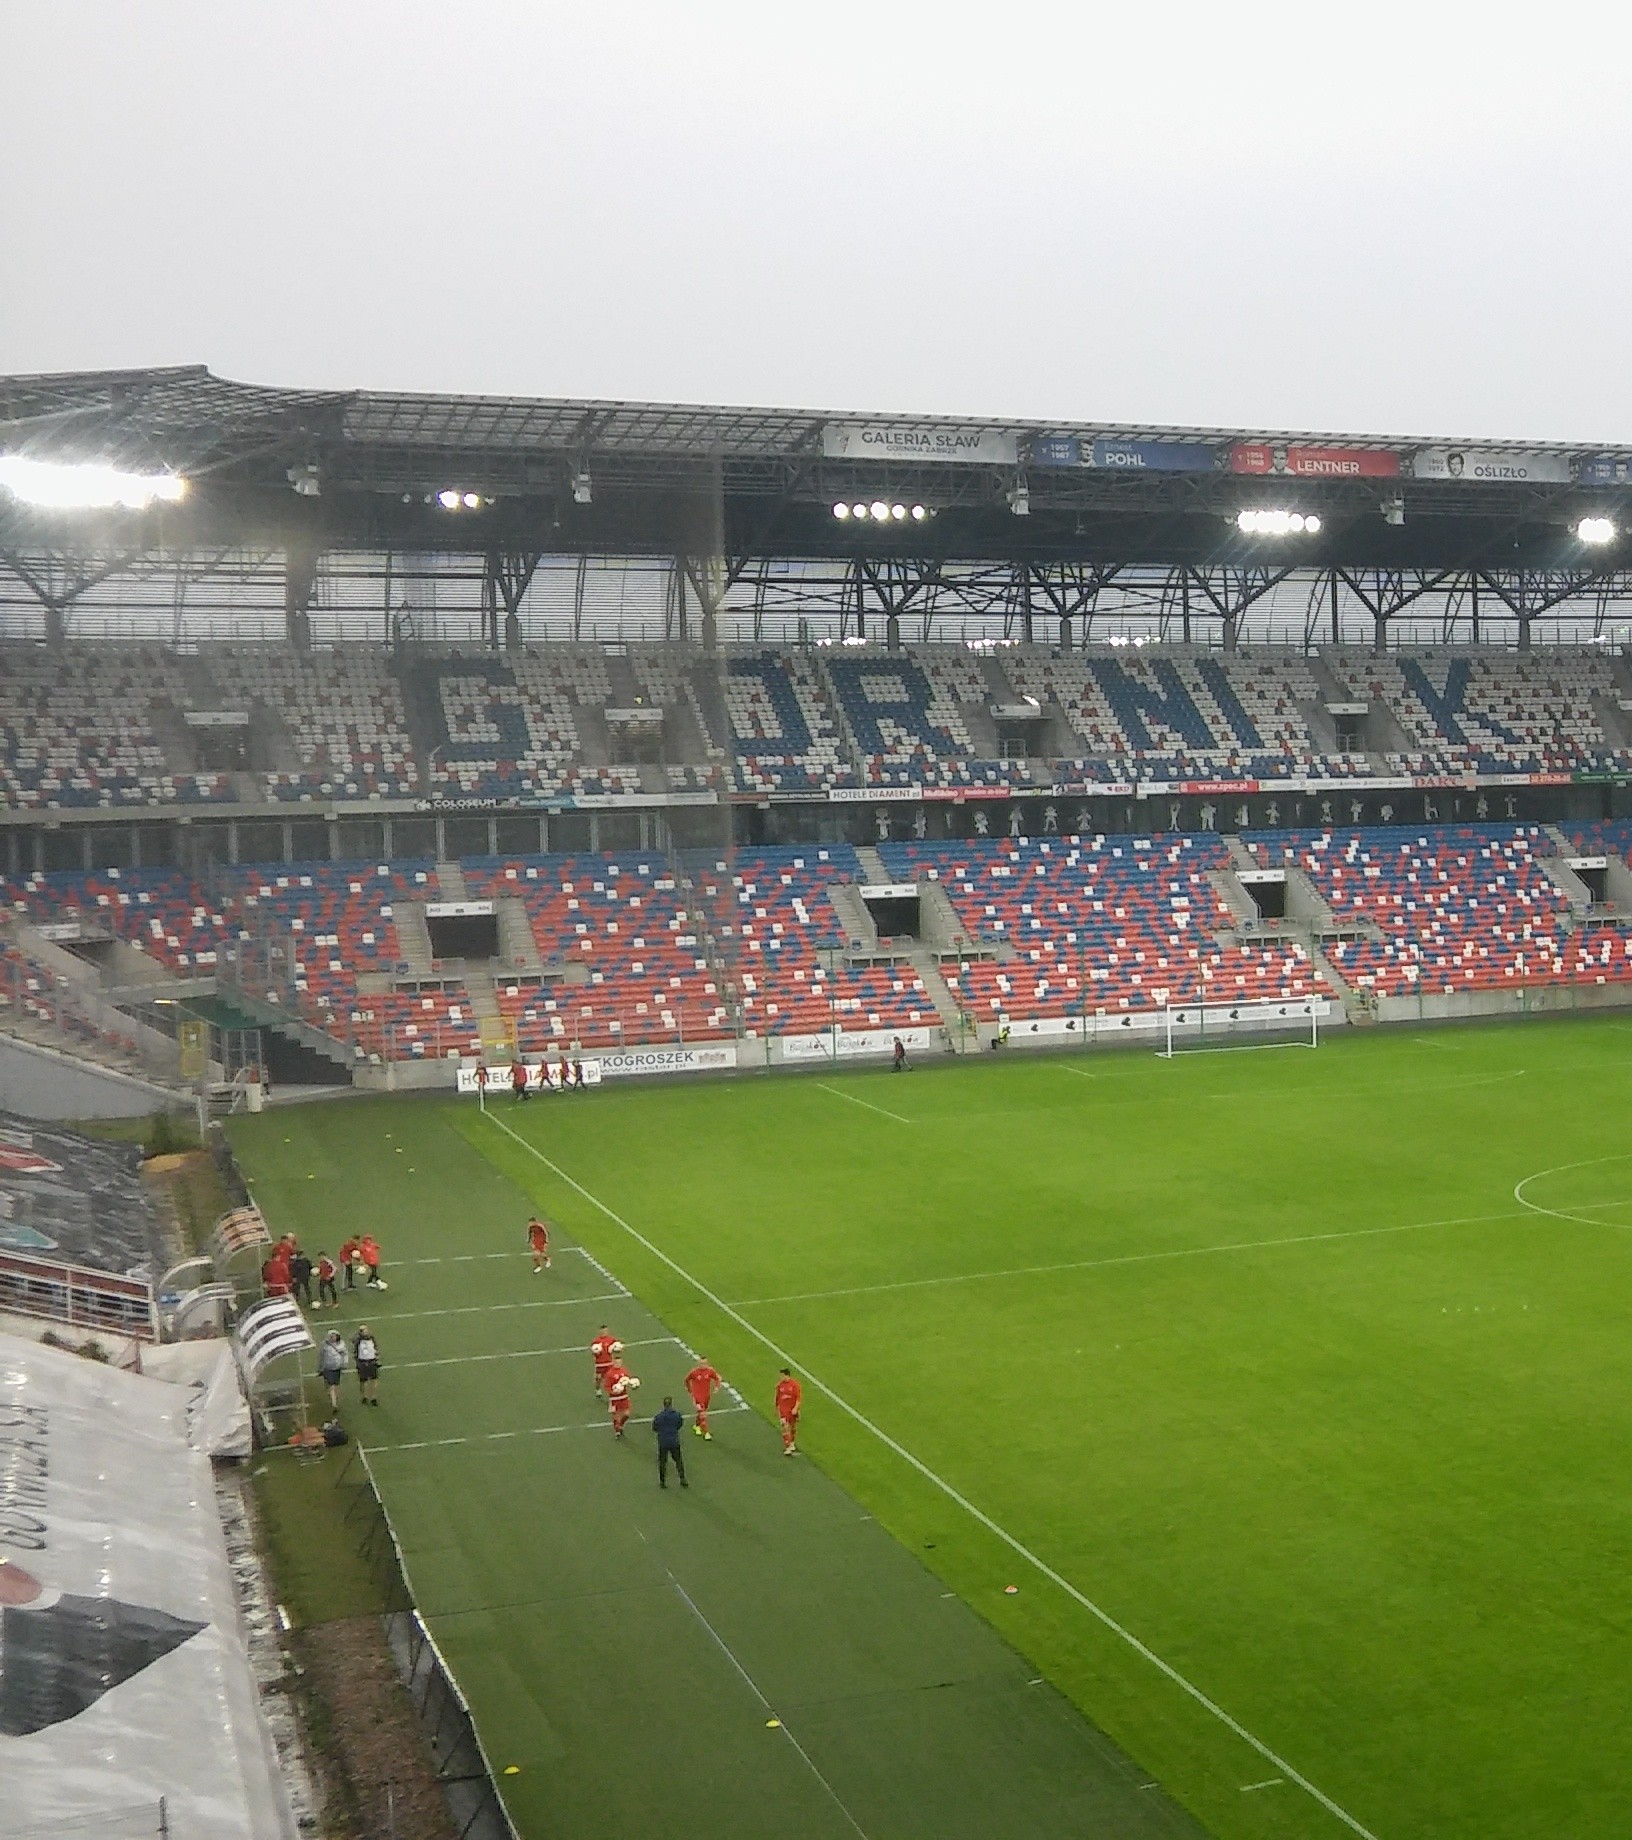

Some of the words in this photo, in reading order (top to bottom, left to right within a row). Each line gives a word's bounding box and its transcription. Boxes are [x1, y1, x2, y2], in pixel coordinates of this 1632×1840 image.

[861, 431, 931, 446] GALERIA
[936, 434, 981, 448] SŁAW
[1104, 452, 1147, 466] POHL
[1296, 460, 1360, 474] LENTNER
[1473, 465, 1528, 479] OŚLIZŁO
[833, 790, 867, 800] HOTELE
[869, 790, 911, 799] DIAMENT
[433, 798, 497, 809] COLOSEUM
